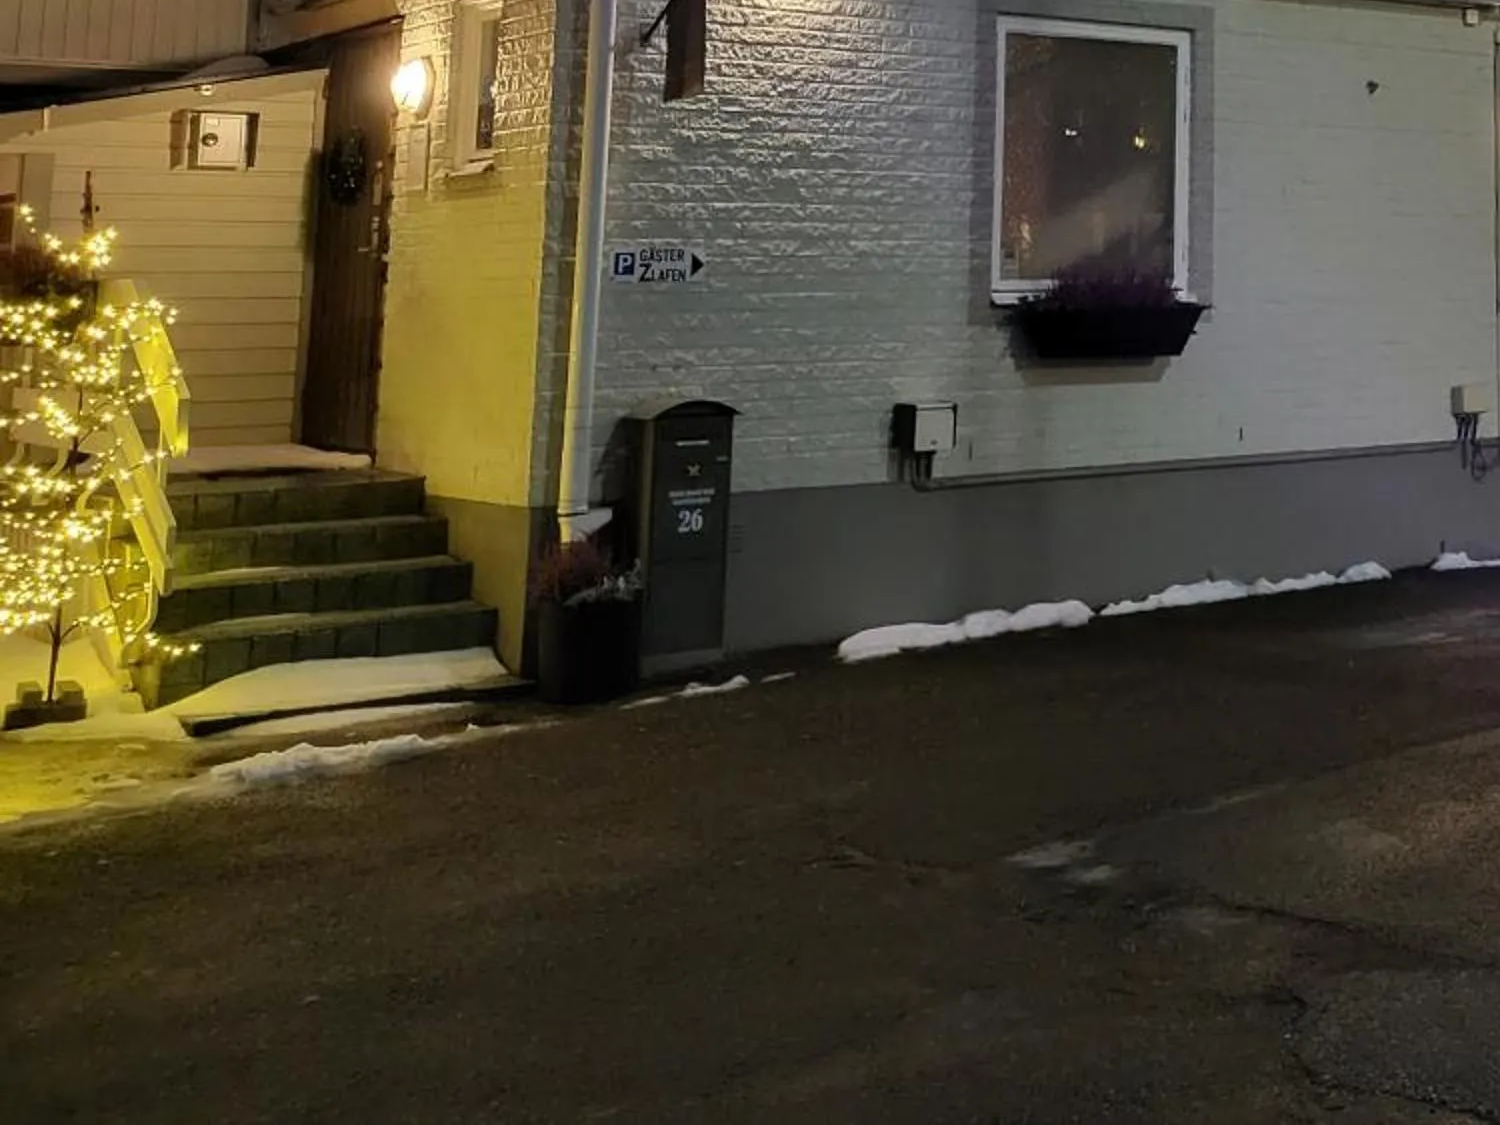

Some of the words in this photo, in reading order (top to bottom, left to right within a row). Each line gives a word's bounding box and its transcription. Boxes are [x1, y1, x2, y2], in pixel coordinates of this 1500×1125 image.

[640, 246, 685, 262] GÄSTER
[617, 254, 633, 274] P
[638, 263, 687, 282] ZLAFEN
[678, 508, 703, 533] 26
